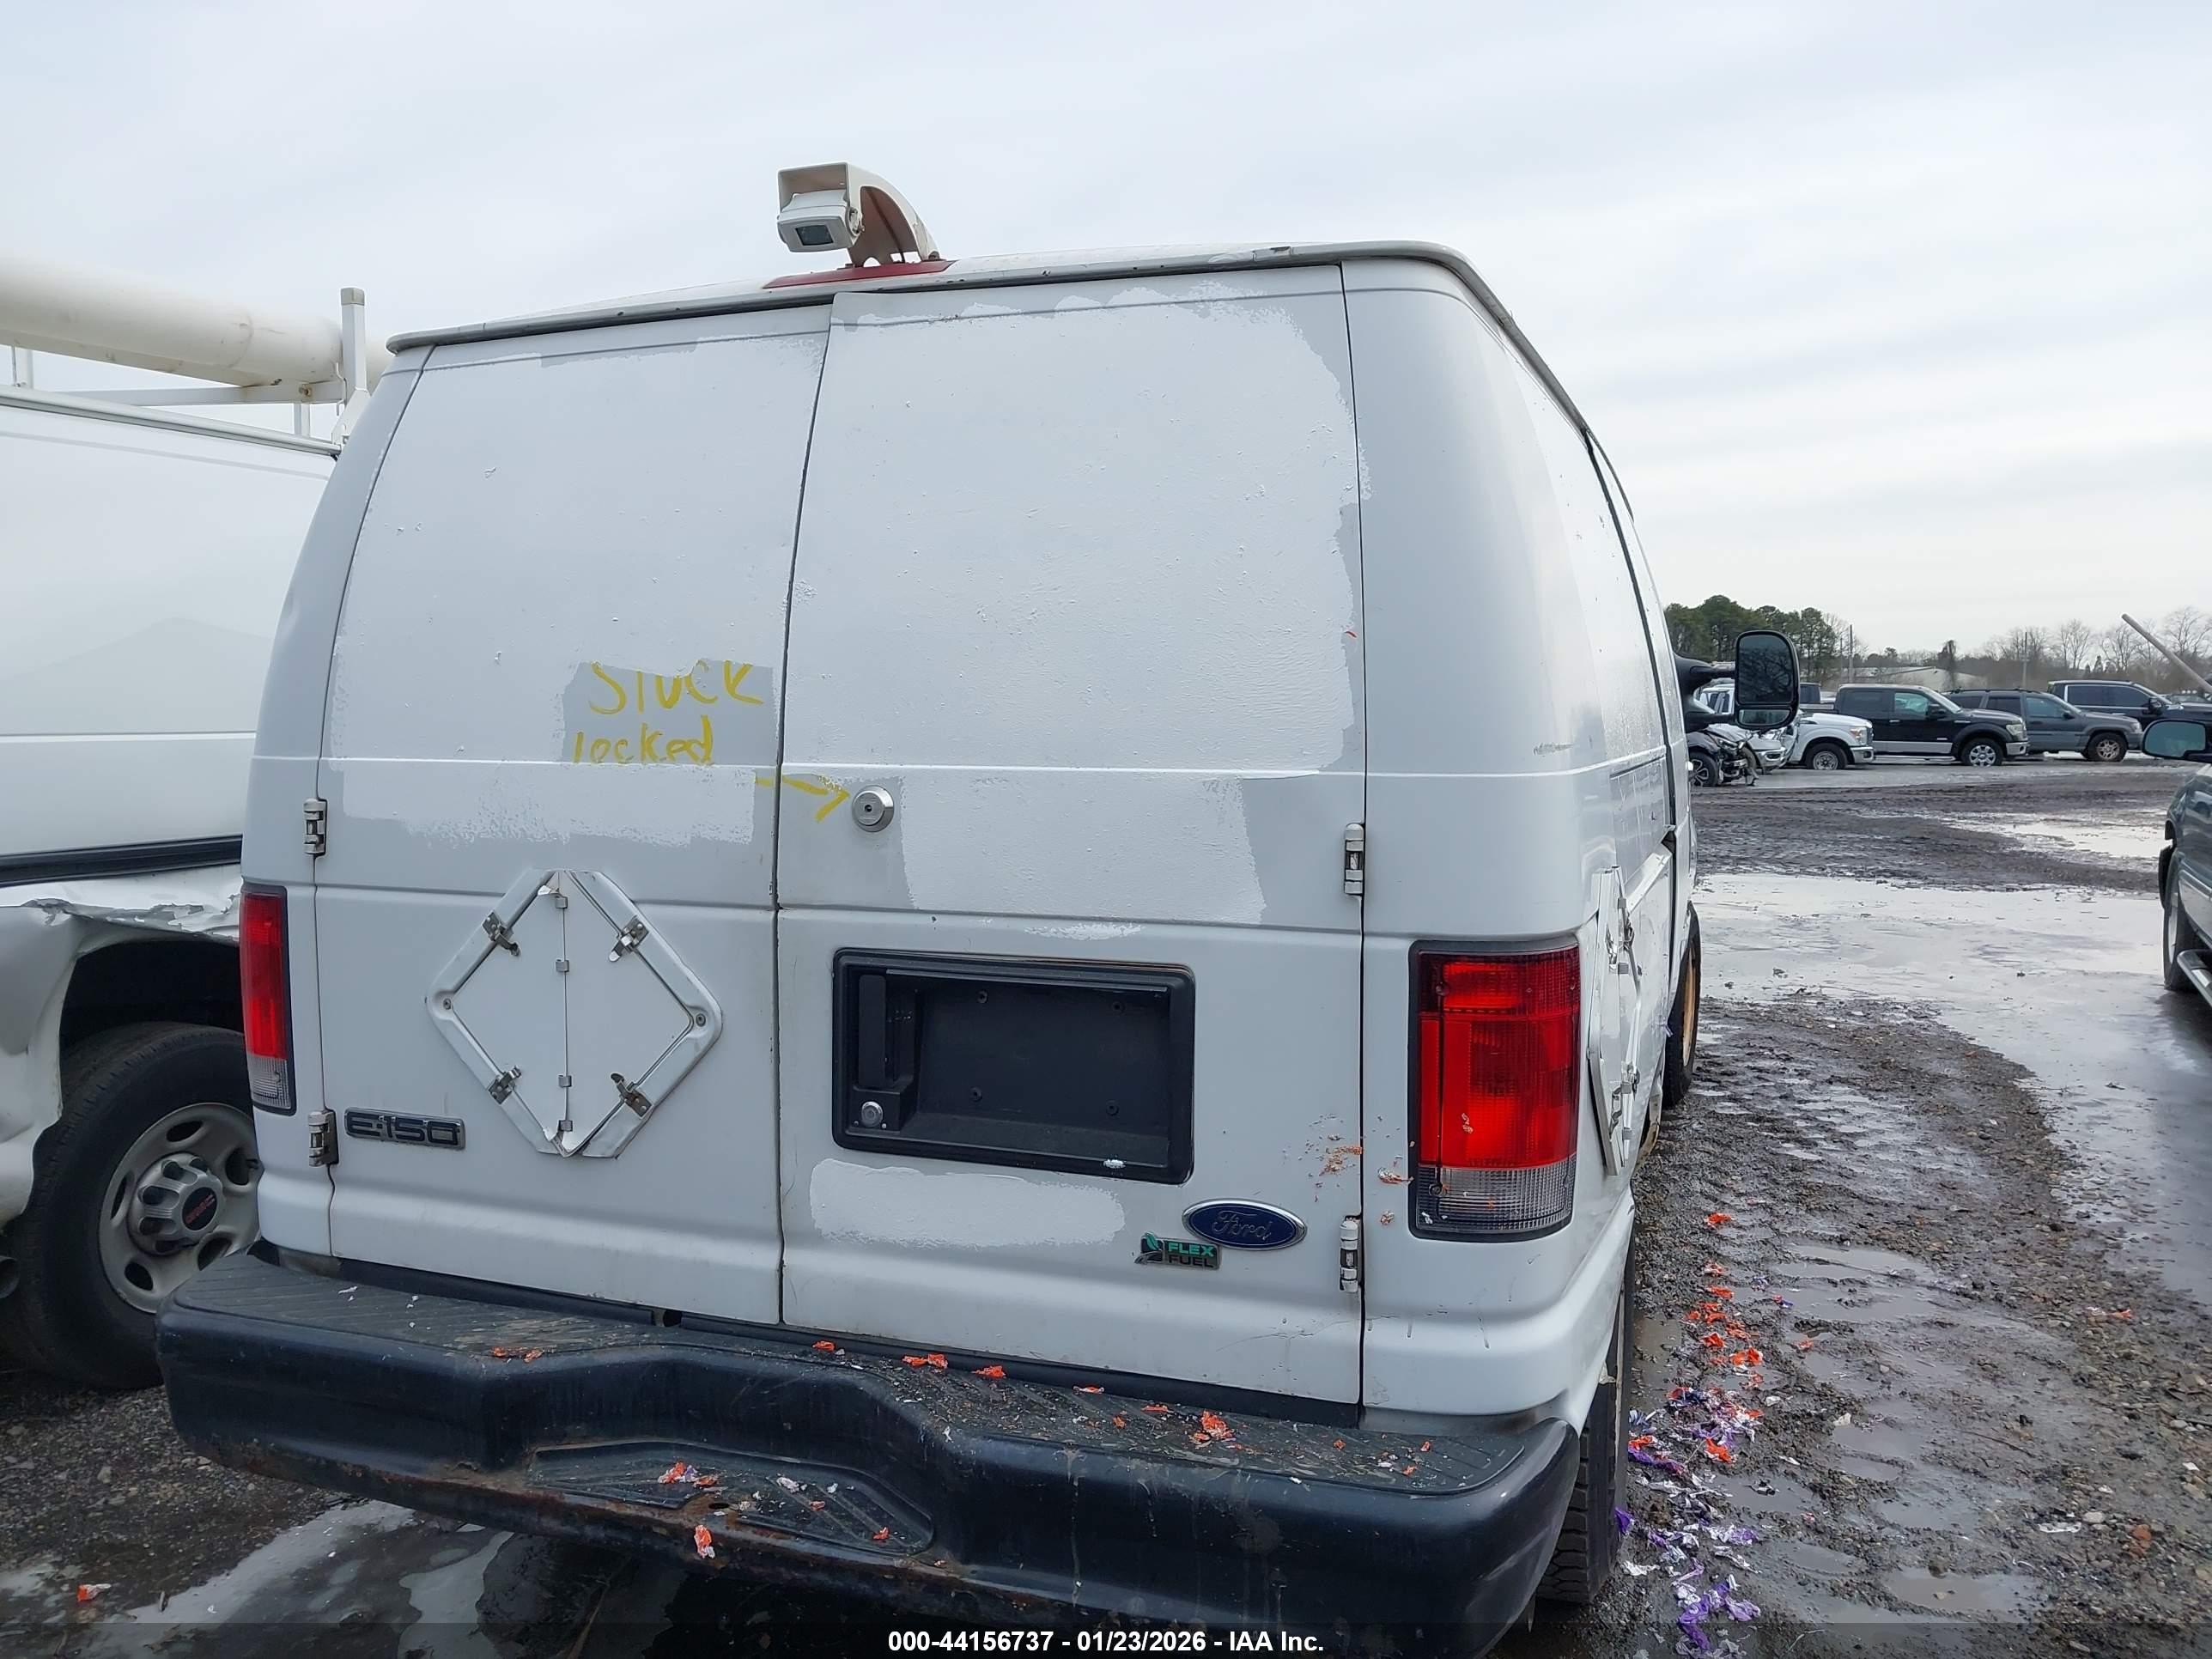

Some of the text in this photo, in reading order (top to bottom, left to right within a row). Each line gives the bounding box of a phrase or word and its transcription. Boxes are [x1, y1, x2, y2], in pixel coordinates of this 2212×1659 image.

[573, 714, 714, 765] locked
[1211, 1210, 1273, 1241] Ford
[1168, 1242, 1214, 1257] FLEX
[1169, 1255, 1214, 1268] FUEL
